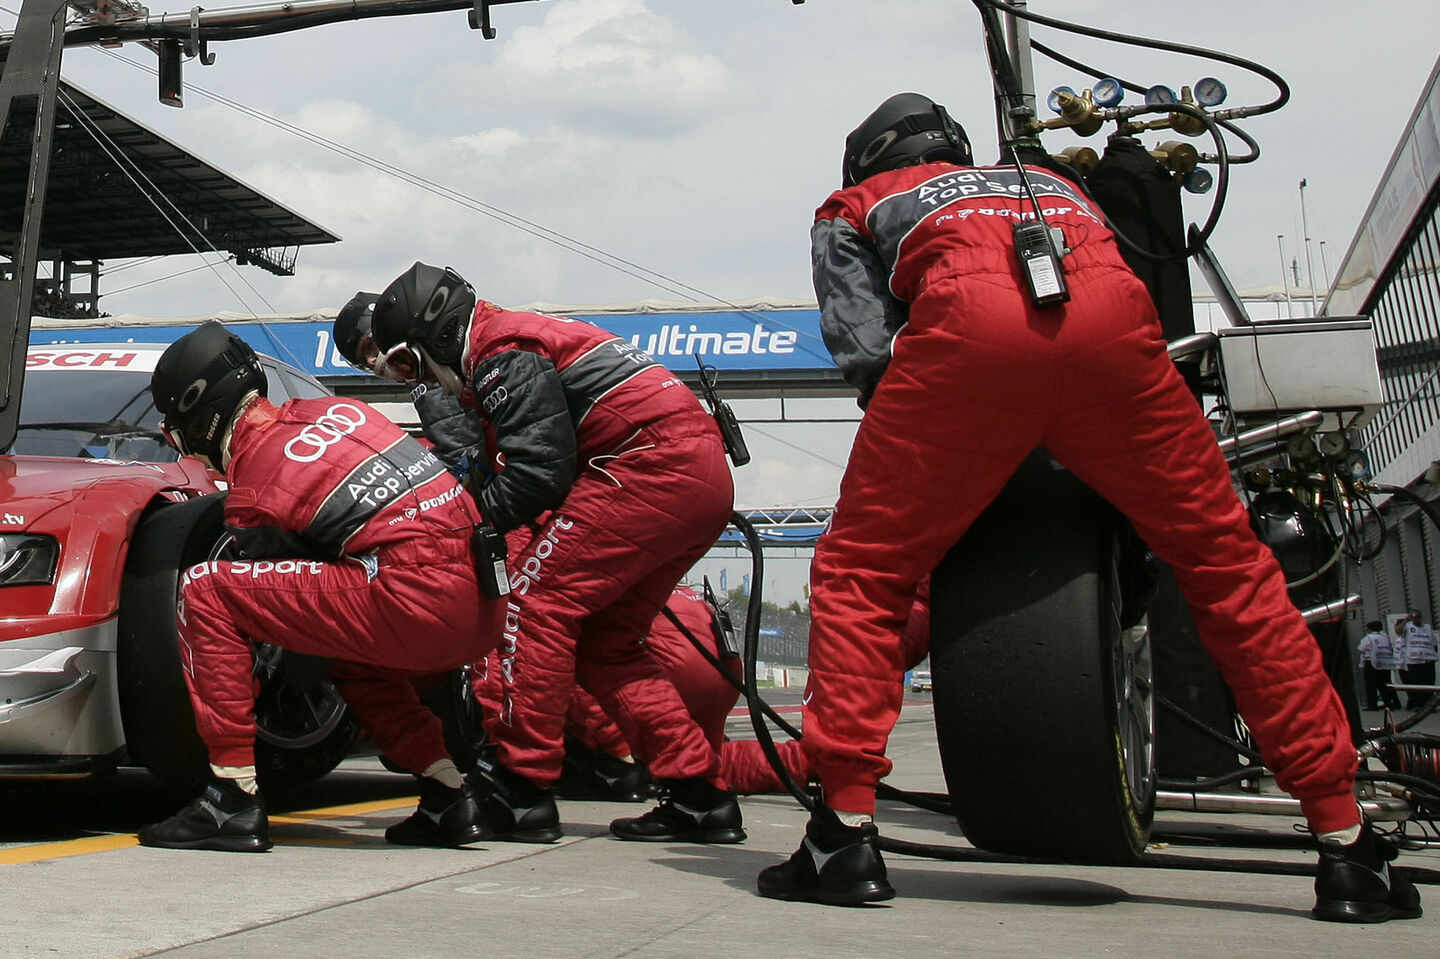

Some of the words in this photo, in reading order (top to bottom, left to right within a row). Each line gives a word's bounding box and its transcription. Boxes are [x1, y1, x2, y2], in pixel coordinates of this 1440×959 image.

[918, 173, 987, 199] Audi
[921, 184, 979, 207] Top
[631, 323, 797, 356] ultimate
[348, 459, 391, 501] Audi
[359, 477, 400, 507] Top
[231, 560, 323, 579] Sport
[501, 602, 520, 683] Audi
[511, 514, 574, 596] Sport
